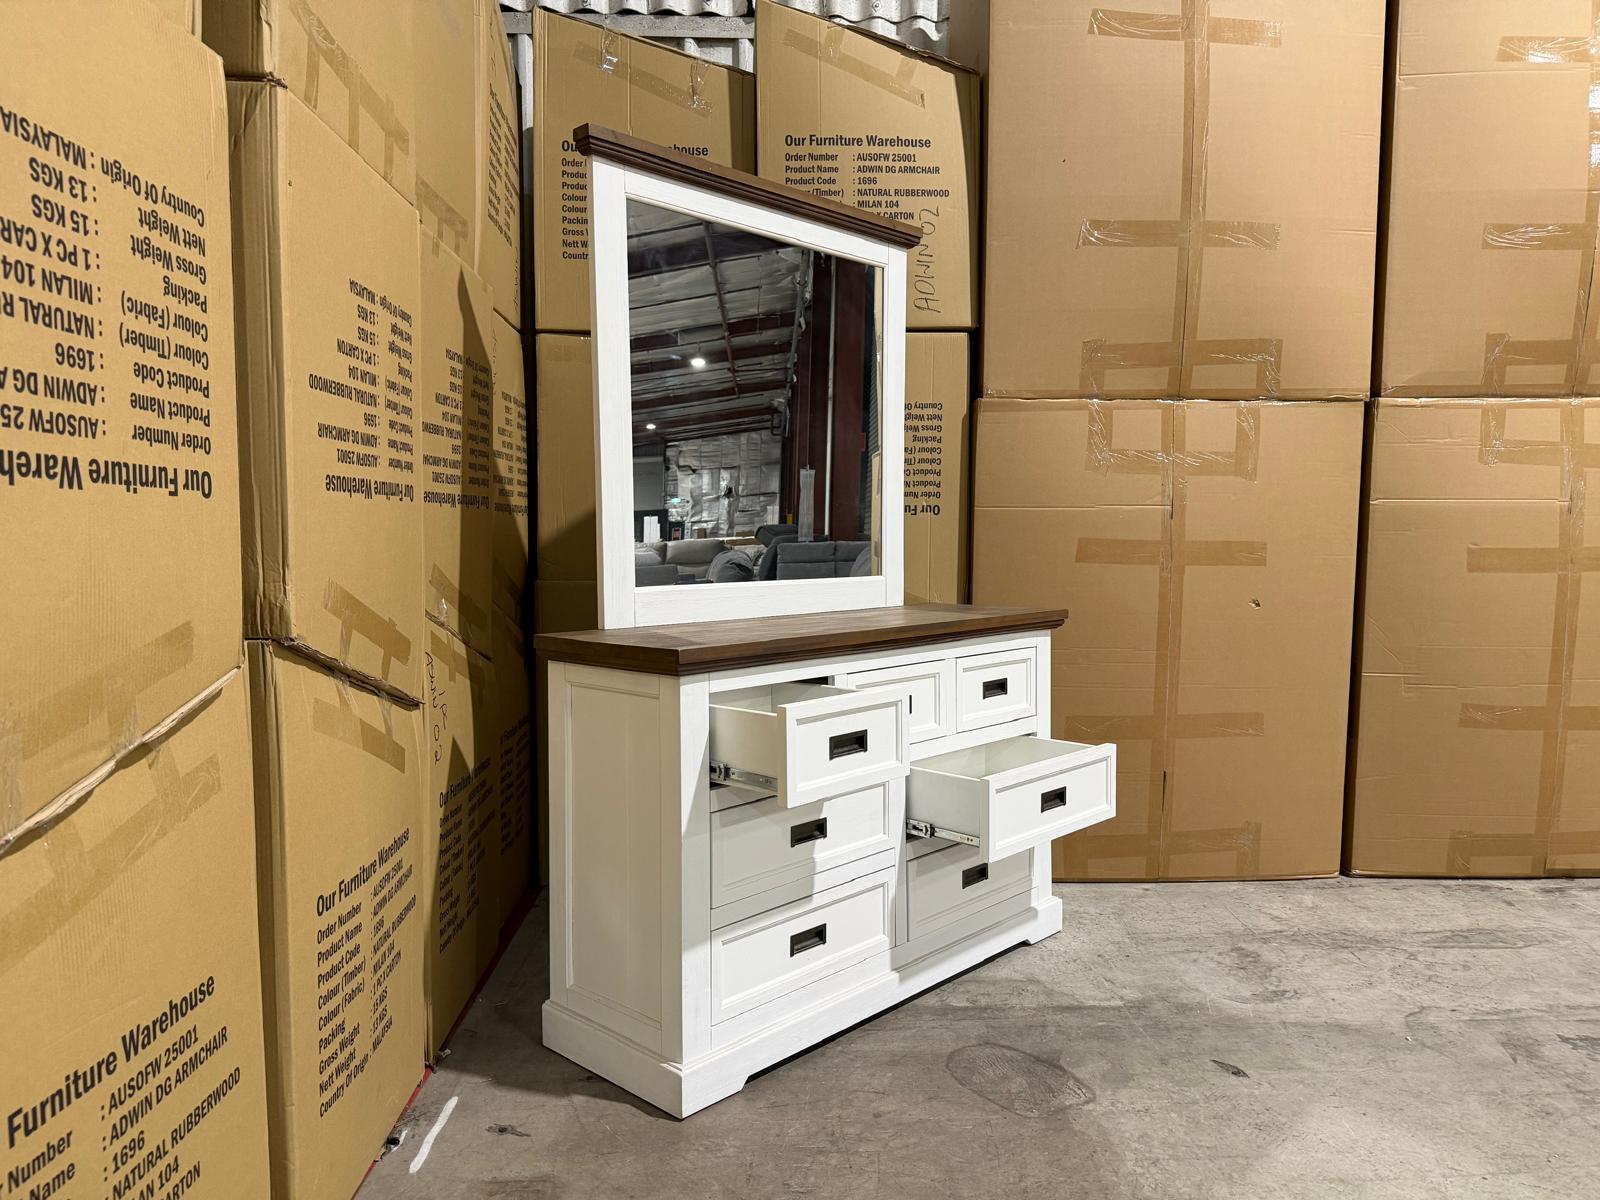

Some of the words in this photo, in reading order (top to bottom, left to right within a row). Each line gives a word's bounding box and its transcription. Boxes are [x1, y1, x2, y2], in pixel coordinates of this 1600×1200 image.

[0, 106, 86, 170] MALAYSIA
[562, 140, 578, 152] Ou
[785, 135, 806, 146] Our
[810, 134, 863, 146] Furniture
[866, 135, 931, 148] Warehouse
[562, 158, 583, 167] Order
[785, 153, 807, 162] Order
[808, 153, 838, 161] Number
[857, 153, 890, 162] AUSOFW
[892, 154, 916, 162] 25001
[786, 165, 815, 173] Product
[817, 165, 839, 173] Name
[886, 166, 896, 174] DG
[898, 166, 940, 174] ARMCHAIR
[29, 157, 64, 193] KGS
[101, 158, 141, 196] Origin
[562, 170, 587, 179] Produc
[562, 182, 587, 190] Produc
[786, 177, 815, 185] Product
[817, 177, 836, 185] Code
[858, 177, 877, 185] 1696
[68, 176, 87, 203] 13
[145, 181, 158, 205] Of
[562, 194, 587, 202] Colour
[812, 188, 844, 198] (Timber)
[858, 188, 892, 197] NATURAL
[894, 189, 950, 197] RUBBERWOOD
[32, 194, 66, 228] KGS
[161, 186, 204, 227] Country
[562, 205, 587, 213] Colour
[858, 200, 882, 208] MILAN
[885, 200, 899, 208] 104
[883, 212, 914, 220] CARTON
[70, 210, 89, 236] 15
[138, 208, 180, 246] Weight
[562, 216, 588, 225] Packin
[562, 228, 584, 236] Gross
[918, 206, 939, 236] 02
[41, 232, 52, 258] X
[56, 239, 78, 267] PC
[130, 235, 174, 272] Weight
[182, 228, 205, 257] Nett
[562, 240, 579, 248] Nett
[82, 248, 91, 271] 1
[563, 251, 588, 260] Countr
[1, 255, 35, 287] 104
[176, 256, 206, 285] Gross
[913, 243, 941, 313] ADWIN
[42, 268, 93, 305] MILAN
[163, 276, 207, 314] Packing
[350, 279, 375, 305] MALAYSIA
[19, 297, 94, 339] NATURAL
[122, 291, 170, 330] (Fabric)
[358, 304, 368, 322] KGS
[369, 311, 375, 326] 13
[173, 313, 208, 342] Colour
[358, 326, 368, 343] KGS
[370, 332, 376, 346] 15
[120, 322, 171, 360] (Timber)
[337, 339, 359, 360] CARTON
[55, 343, 95, 371] 1696
[174, 344, 209, 371] Colour
[360, 348, 364, 362] X
[365, 351, 372, 365] PC
[373, 354, 376, 366] 1
[13, 369, 38, 396] DG
[134, 362, 164, 388] Code
[167, 370, 209, 399] Product
[348, 365, 359, 381] 104
[360, 370, 377, 387] MILAN
[44, 375, 97, 405] ADWIN
[309, 374, 352, 400] RUBBERWOOD
[354, 388, 377, 408] NATURAL
[130, 393, 165, 419] Name
[168, 401, 210, 427] Product
[905, 403, 912, 411] Of
[905, 412, 925, 422] Weig
[914, 401, 943, 411] Country
[927, 414, 942, 422] Nett
[29, 408, 99, 439] AUSOFW
[318, 423, 350, 442] ARMCHAIR
[364, 412, 377, 428] 1696
[904, 424, 920, 433] Wei
[921, 425, 942, 433] Gross
[132, 425, 179, 451] Number
[181, 434, 211, 455] Order
[352, 430, 359, 445] DG
[361, 432, 377, 448] ADWIN
[912, 435, 942, 444] Packing
[337, 449, 355, 465] 25001
[356, 452, 378, 467] AUSOFW
[918, 447, 942, 455] Colour
[918, 458, 942, 466] Colour
[89, 459, 178, 497] Furniture
[183, 469, 212, 499] Our
[326, 475, 372, 499] Warehouse
[374, 481, 403, 502] Furniture
[404, 485, 414, 502] Our
[424, 491, 456, 508] Warehouse
[458, 494, 480, 509] Furniture
[481, 496, 489, 510] Our
[920, 505, 940, 516] Our
[317, 891, 336, 916] Our
[339, 860, 377, 901] Furniture
[378, 828, 409, 868] Warehouse
[317, 922, 337, 944] Order
[338, 902, 362, 929] Number
[318, 935, 344, 967] Product
[346, 922, 362, 946] Name
[318, 956, 344, 989] Product
[346, 944, 360, 965] Code
[318, 983, 340, 1010] Colour
[342, 956, 366, 992] (Timber)
[319, 1004, 341, 1031] Colour
[342, 978, 365, 1013] (Fabric)
[319, 1018, 345, 1054] Packing
[320, 1049, 338, 1075] Gross
[339, 1024, 360, 1054] Weight
[8, 1052, 117, 1149] Furniture
[122, 976, 214, 1062] Warehouse
[320, 1072, 334, 1097] Nett
[335, 1049, 357, 1079] Weight
[320, 1082, 345, 1118] Country
[346, 1070, 352, 1088] Of
[354, 1054, 369, 1079] Origin
[8, 1131, 72, 1193] Number
[109, 1054, 162, 1115] AUSOFW
[164, 1026, 198, 1068] 25001
[30, 1163, 75, 1200] Name
[110, 1092, 153, 1146] ADWIN
[156, 1076, 172, 1105] DG
[174, 1027, 228, 1089] ARMCHAIR
[113, 1139, 169, 1200] NATURAL
[171, 1068, 240, 1149] RUBBERWOOD
[113, 1131, 145, 1174] 1696
[158, 1156, 179, 1190] 104
[162, 1161, 200, 1200] ARTON
